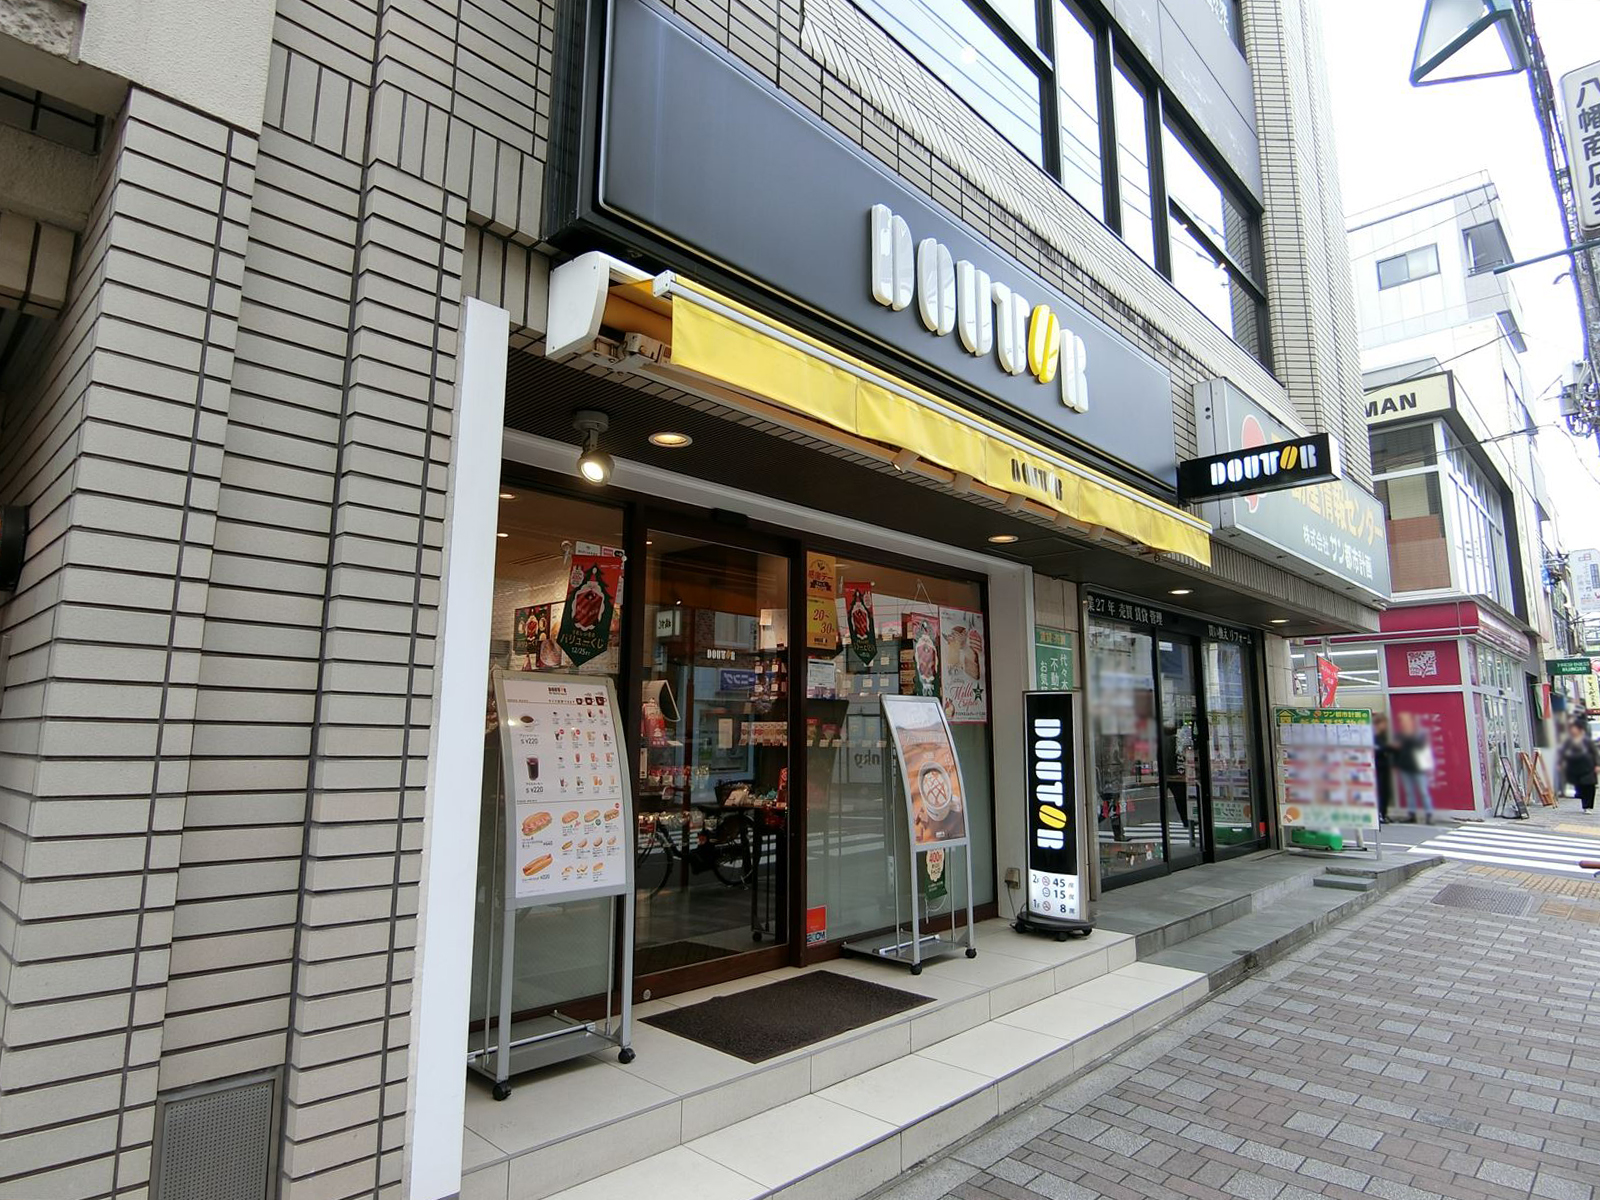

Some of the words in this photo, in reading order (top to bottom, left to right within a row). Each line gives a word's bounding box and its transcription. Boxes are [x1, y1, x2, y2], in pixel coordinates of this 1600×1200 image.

[871, 203, 1089, 413] DOUTOR
[1011, 458, 1063, 501] DOTR
[1210, 445, 1318, 486] DOUTOR
[1040, 660, 1048, 690] お気
[1050, 657, 1059, 690] 不動
[1034, 718, 1067, 850] DOUTOR
[1052, 878, 1066, 888] 45
[1054, 889, 1066, 900] 15
[1060, 903, 1067, 914] 8
